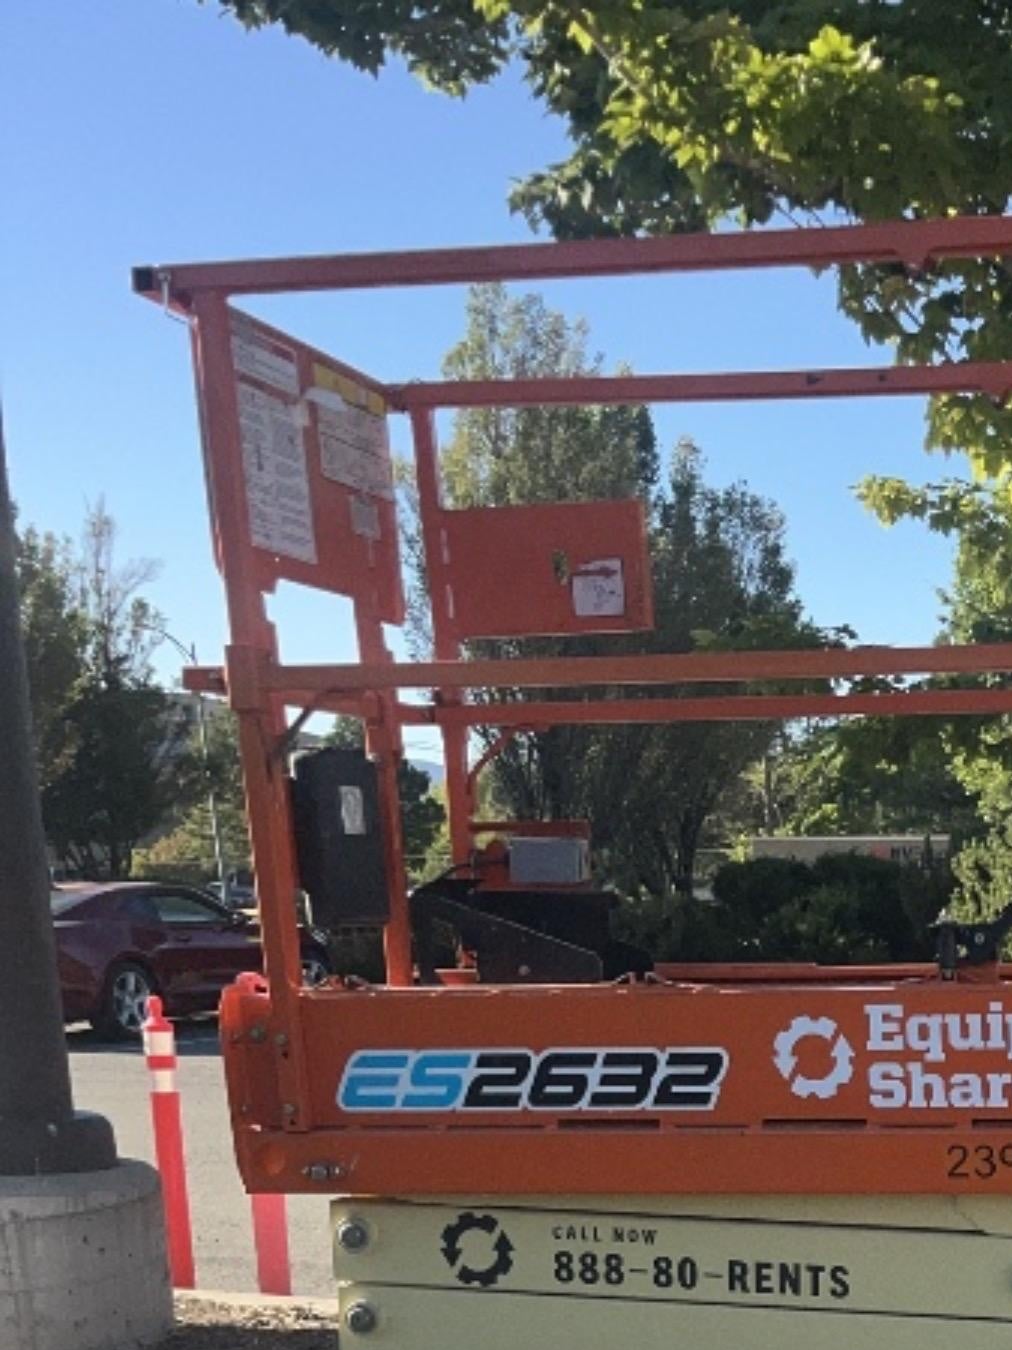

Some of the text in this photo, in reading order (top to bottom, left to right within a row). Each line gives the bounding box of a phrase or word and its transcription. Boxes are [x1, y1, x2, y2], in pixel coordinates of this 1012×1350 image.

[337, 1047, 729, 1113] ES2632
[552, 1225, 659, 1246] CALL NOW
[553, 1250, 851, 1300] 888-80-RENTS
